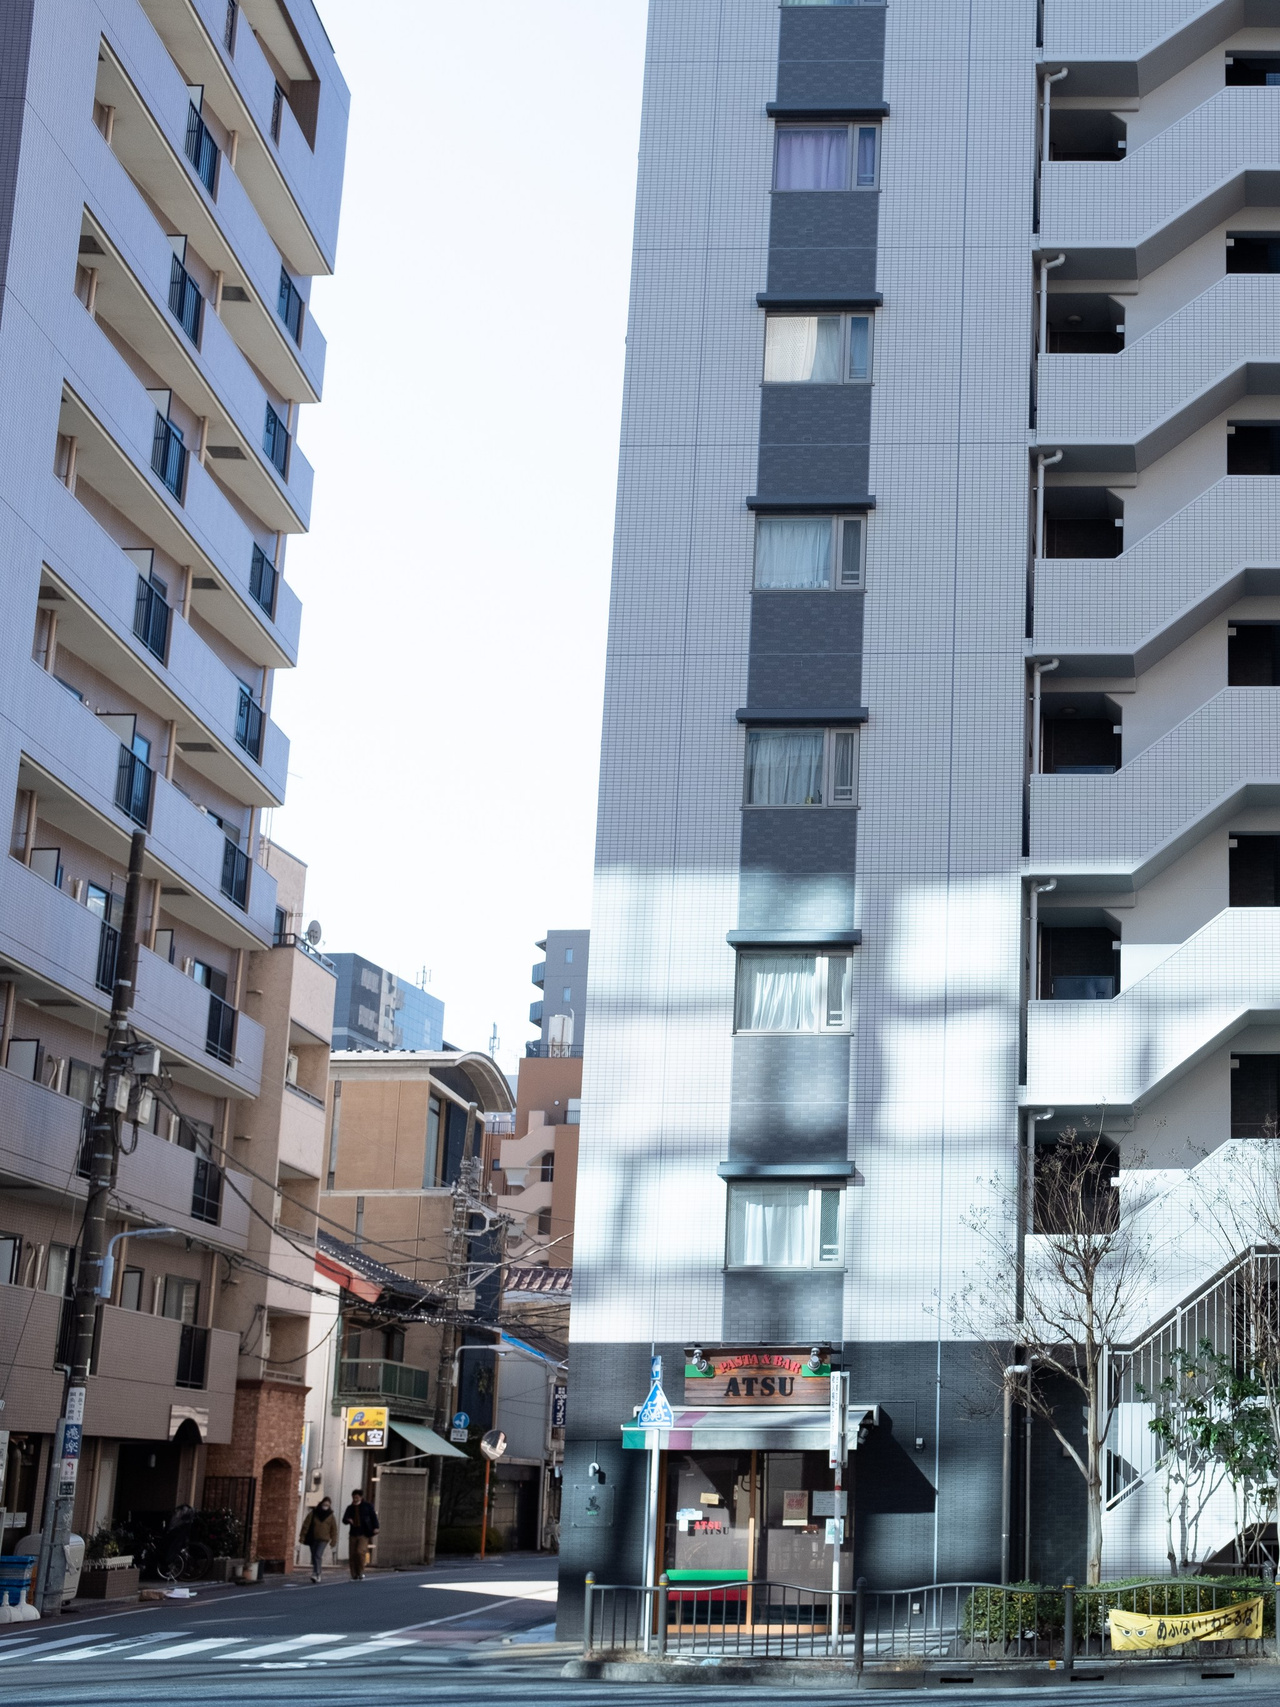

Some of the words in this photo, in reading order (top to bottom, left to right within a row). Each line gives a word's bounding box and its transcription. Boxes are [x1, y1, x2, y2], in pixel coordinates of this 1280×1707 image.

[718, 1354, 760, 1374] PASTA
[761, 1354, 772, 1365] &
[773, 1355, 802, 1375] BAR
[724, 1376, 795, 1397] ATSU
[693, 1520, 722, 1530] ATSU
